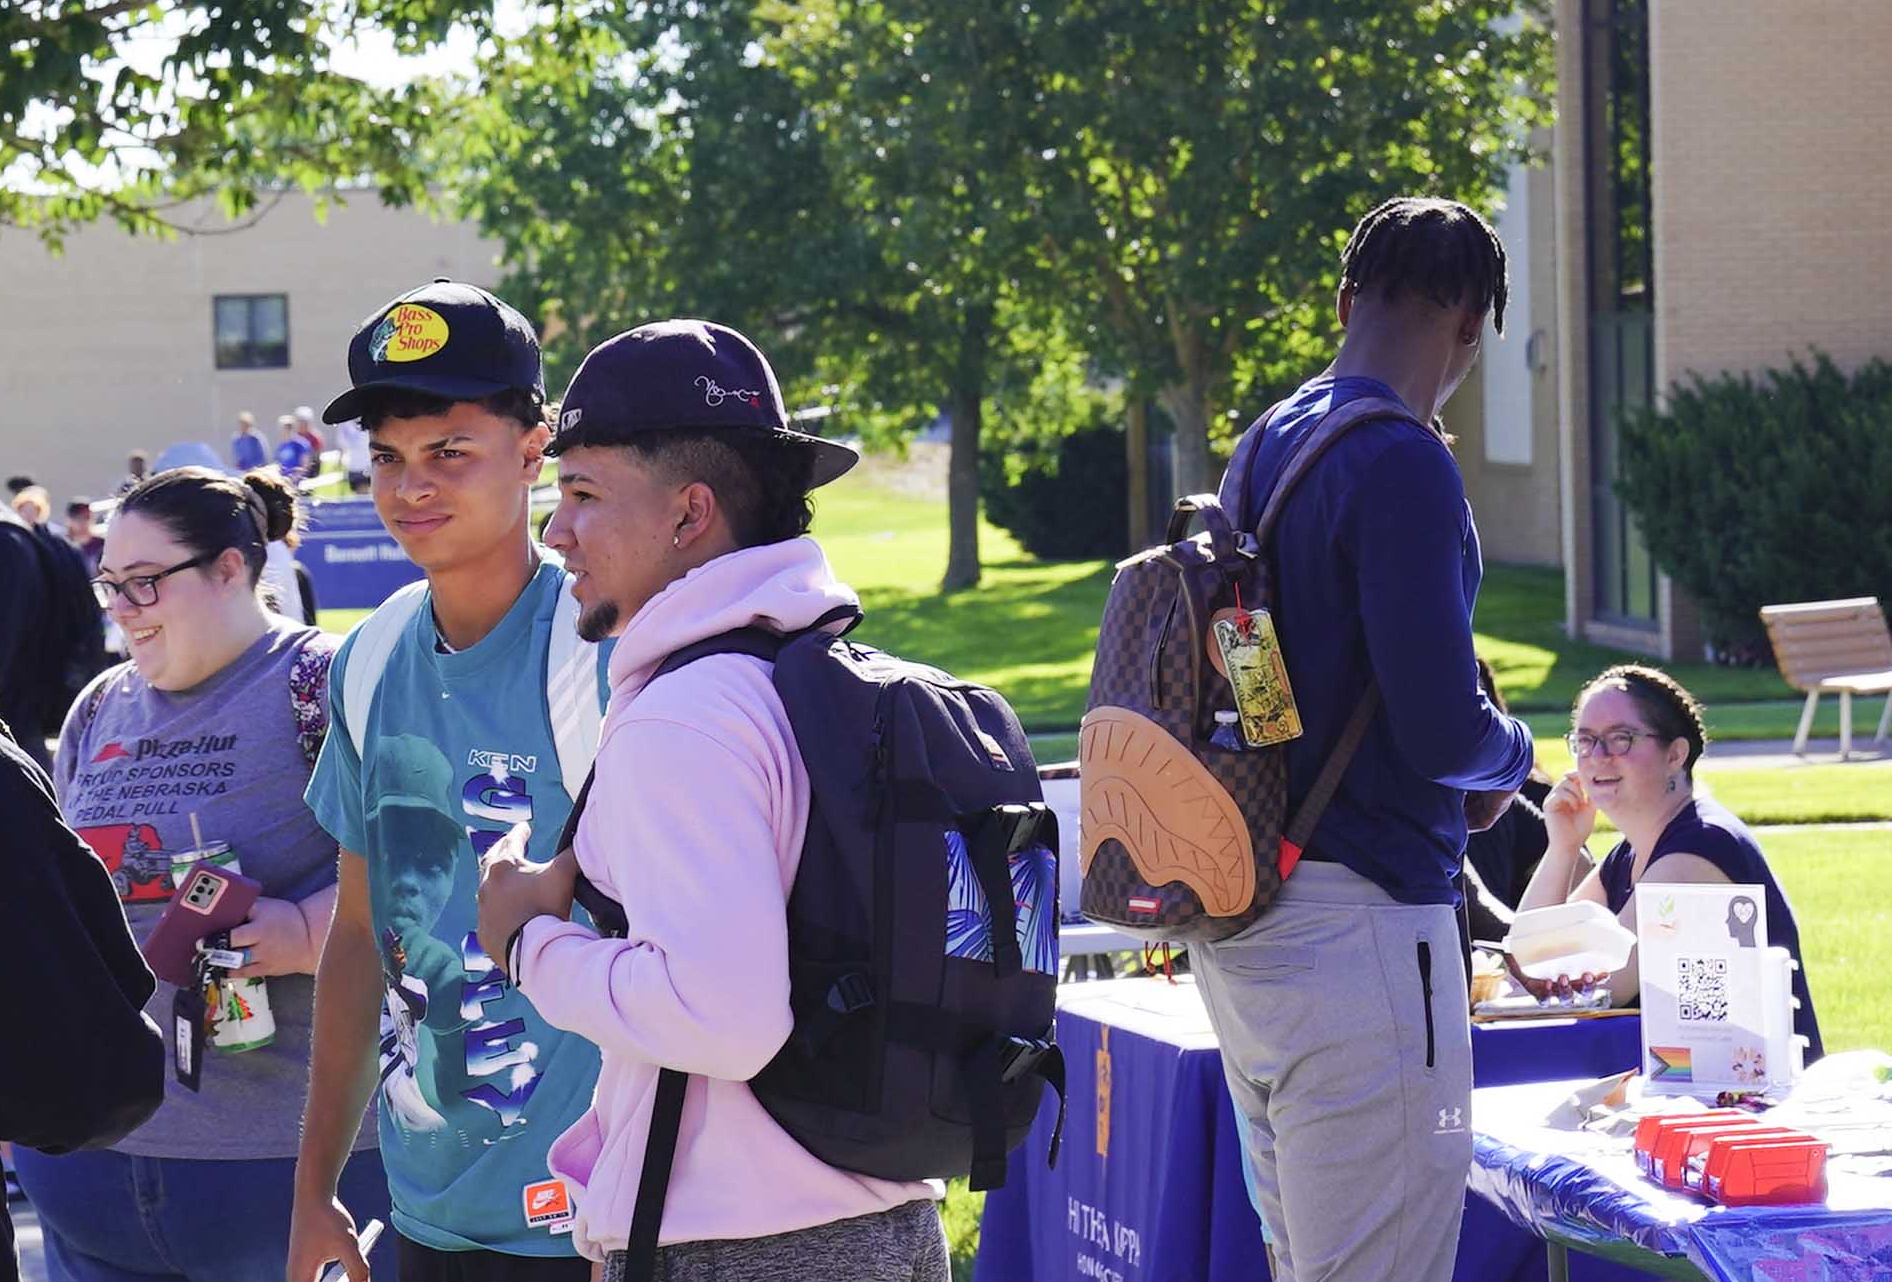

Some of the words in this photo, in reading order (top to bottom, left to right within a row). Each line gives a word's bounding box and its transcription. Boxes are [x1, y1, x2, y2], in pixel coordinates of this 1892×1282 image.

[397, 306, 433, 323] Bass
[397, 321, 423, 336] Pro
[396, 336, 440, 352] Shops
[467, 748, 537, 773] KEN
[126, 761, 236, 783] SPONSORS
[116, 781, 228, 801] NEBRASKA
[131, 800, 179, 818] PULL
